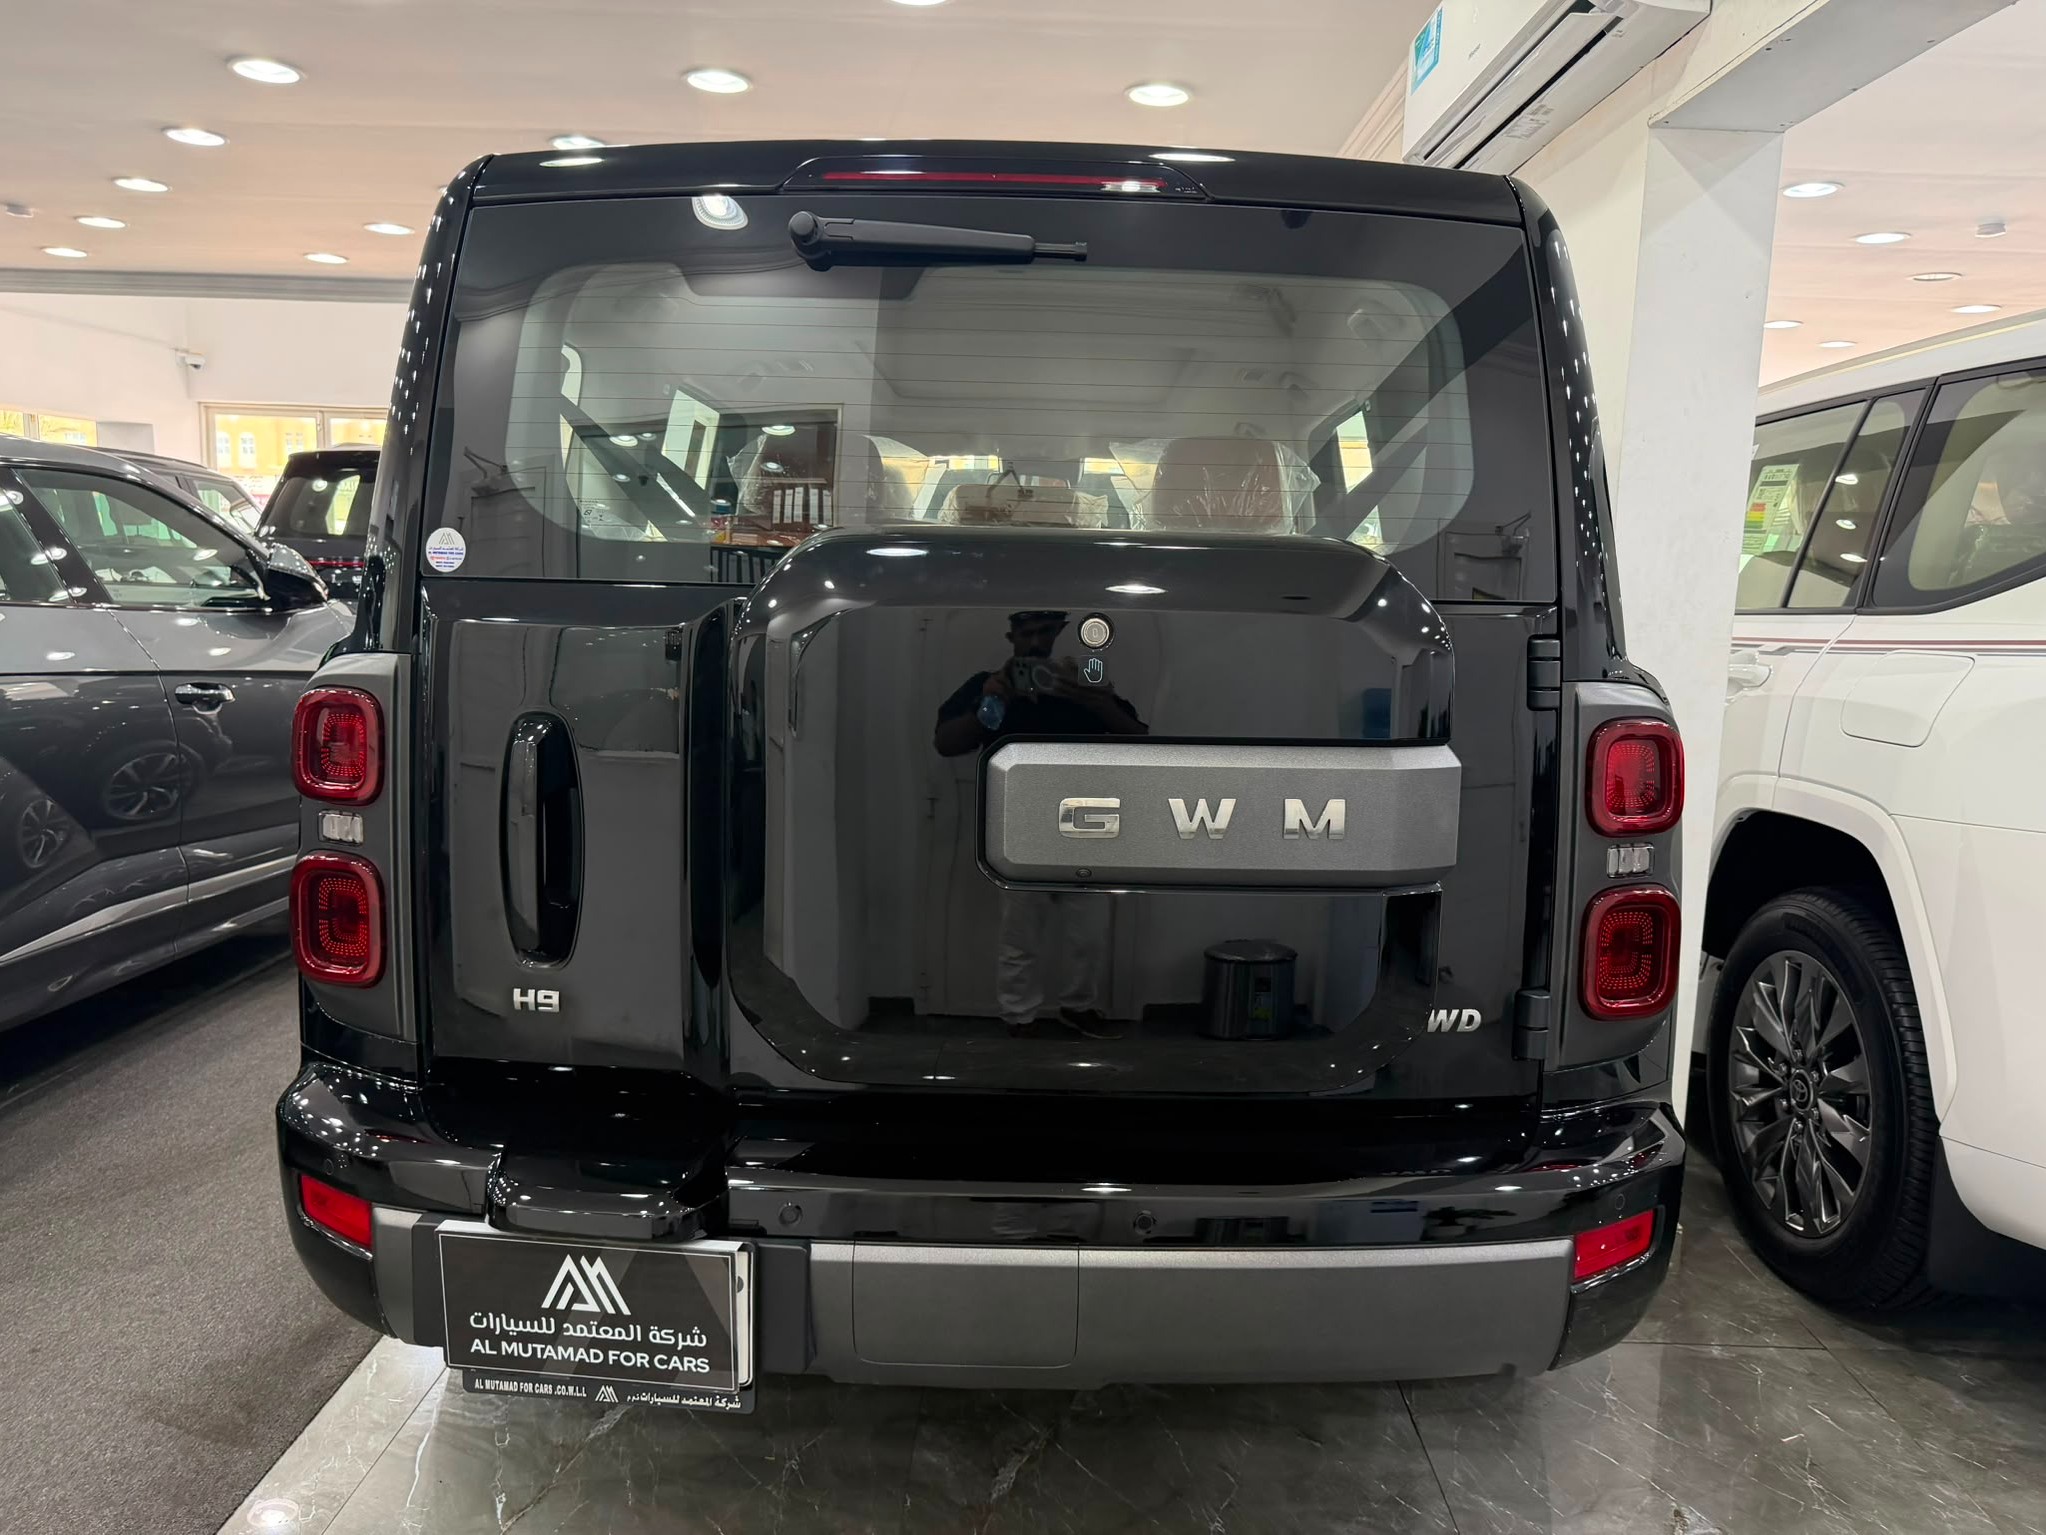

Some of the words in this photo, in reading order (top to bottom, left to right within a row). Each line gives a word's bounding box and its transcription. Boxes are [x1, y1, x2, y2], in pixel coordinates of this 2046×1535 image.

[1057, 796, 1347, 840] GWM
[513, 988, 560, 1013] H9
[469, 1311, 556, 1336] للسيارات
[562, 1320, 642, 1342] المعتمد
[648, 1325, 708, 1351] شركة
[470, 1338, 498, 1355] AL
[501, 1340, 605, 1364] MUTAMAD
[607, 1349, 651, 1369] FOR
[653, 1354, 711, 1374] CARS
[474, 1378, 484, 1390] AL
[485, 1379, 519, 1392] MUTAMAD
[519, 1381, 534, 1394] FOR
[535, 1383, 553, 1395] CARS
[681, 1395, 713, 1407] المعتمد
[714, 1394, 742, 1410] شركة
